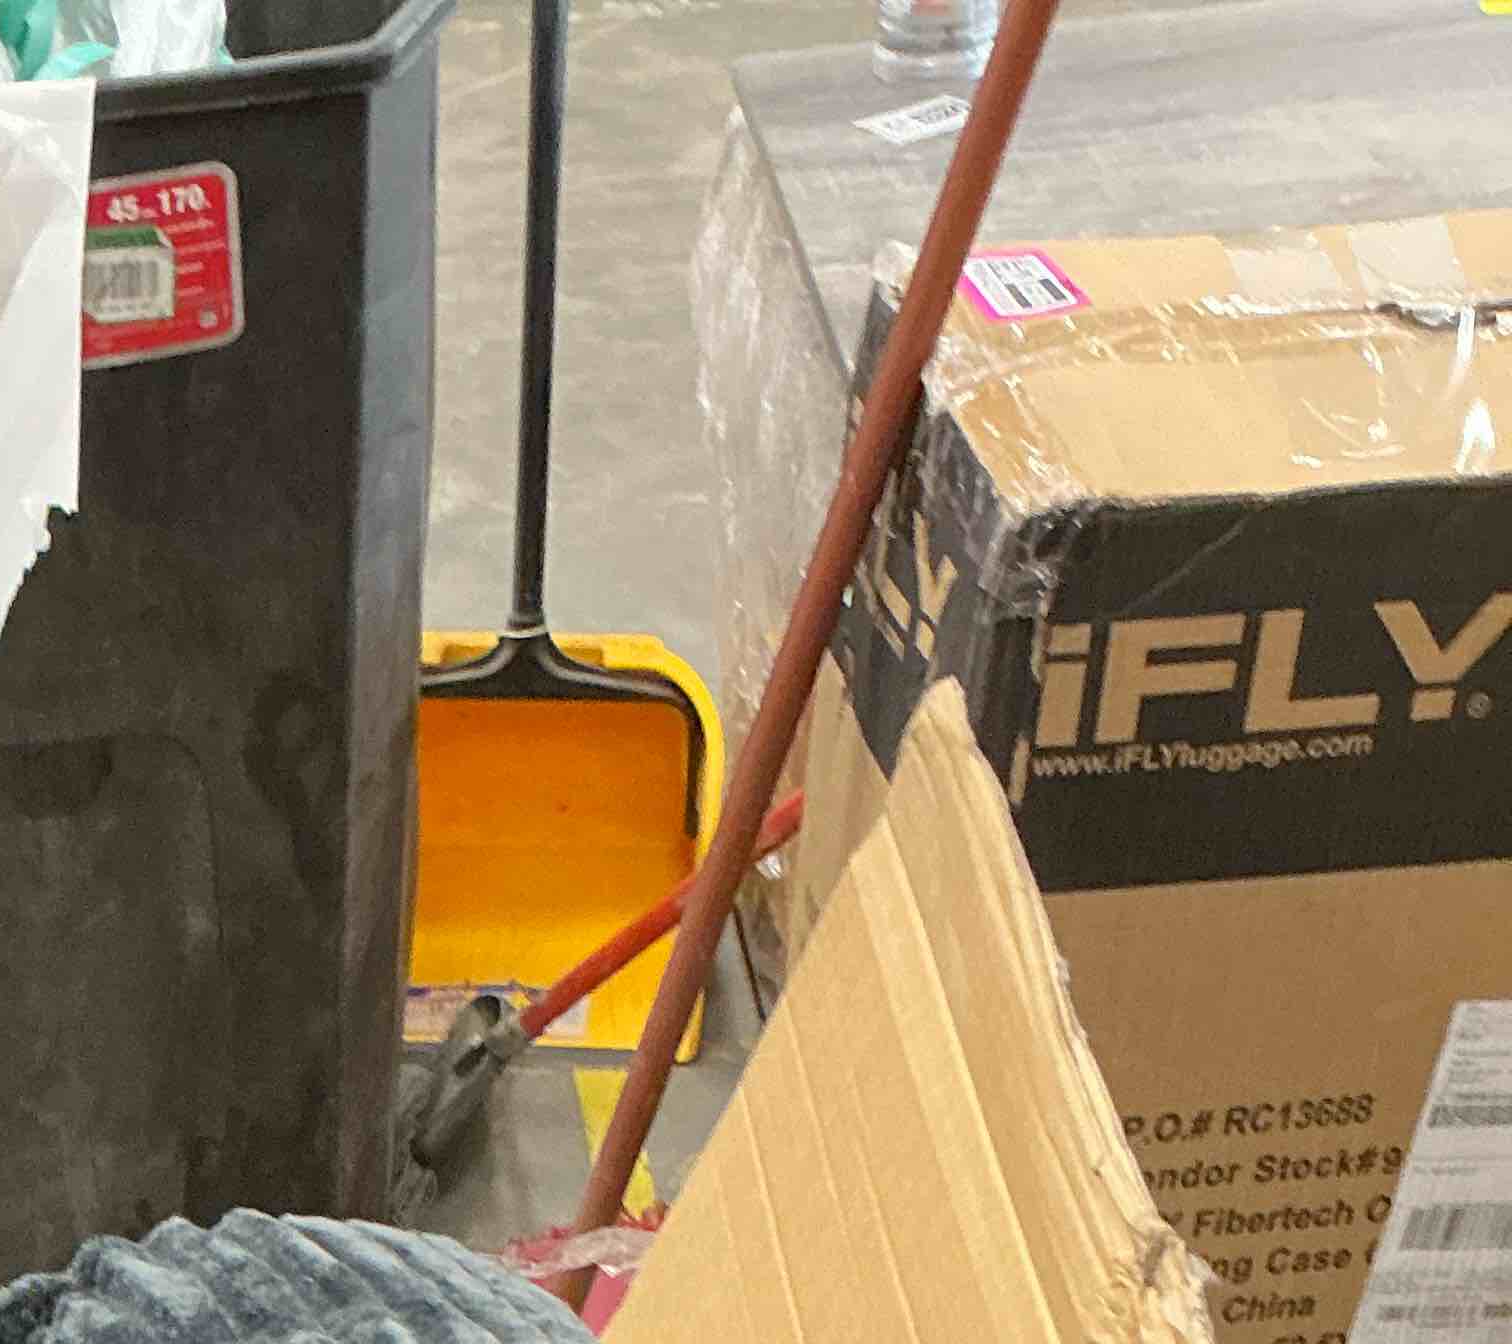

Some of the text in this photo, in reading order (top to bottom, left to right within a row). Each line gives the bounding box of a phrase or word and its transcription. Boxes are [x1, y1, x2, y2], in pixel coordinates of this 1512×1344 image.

[1032, 733, 1376, 778] www.iFLYluggage.com
[1193, 1200, 1355, 1237] Fibertech
[1265, 1248, 1352, 1275] Case
[1221, 1294, 1316, 1324] China
